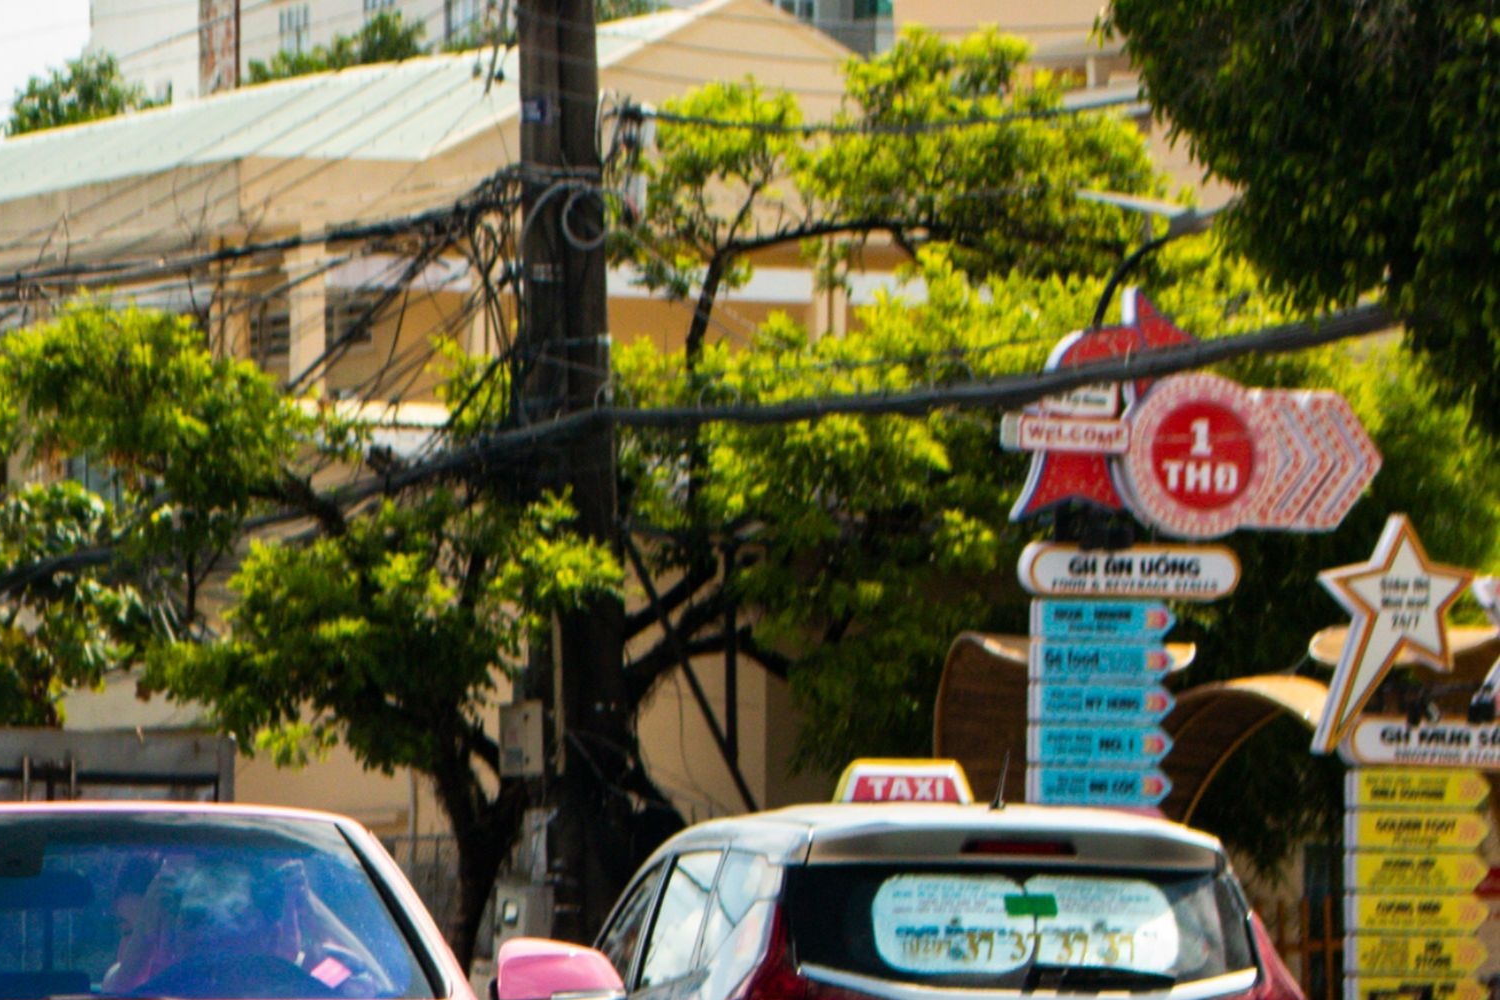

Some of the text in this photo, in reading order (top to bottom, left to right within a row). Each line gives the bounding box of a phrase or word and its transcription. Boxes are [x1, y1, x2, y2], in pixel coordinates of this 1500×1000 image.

[1027, 424, 1123, 449] WELCOME
[1190, 417, 1213, 457] 1
[867, 776, 944, 801] TAXI
